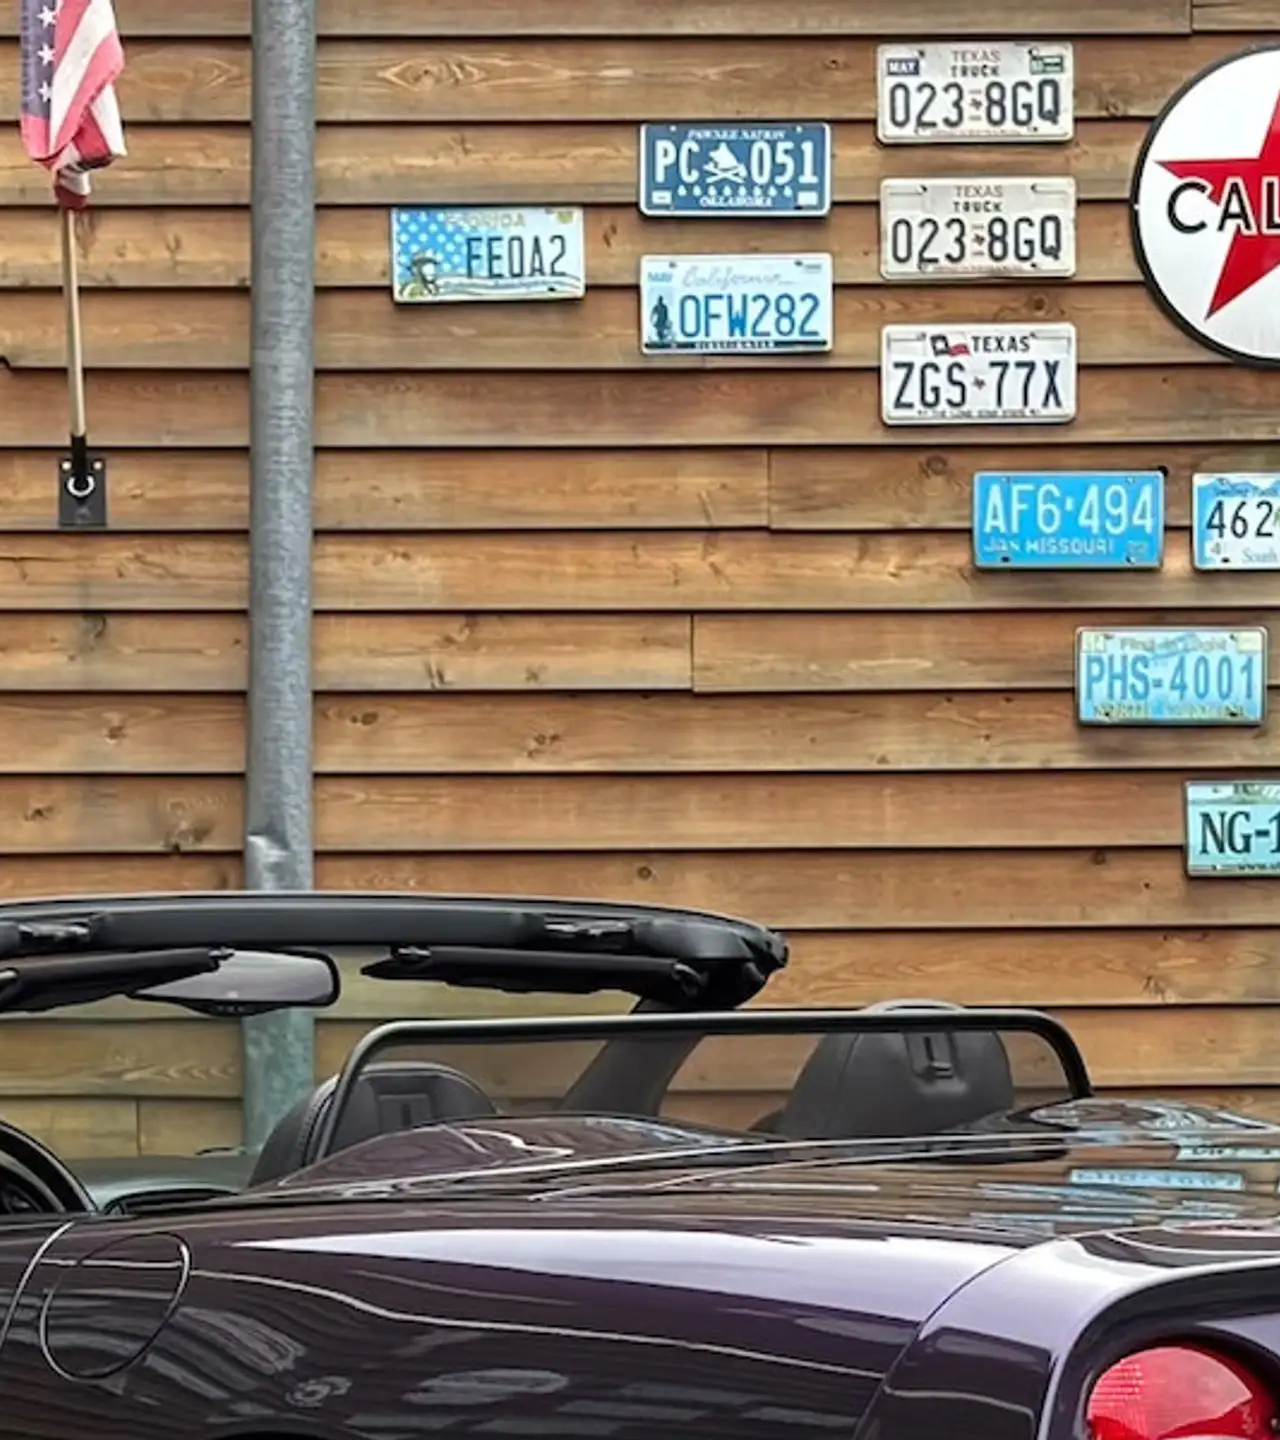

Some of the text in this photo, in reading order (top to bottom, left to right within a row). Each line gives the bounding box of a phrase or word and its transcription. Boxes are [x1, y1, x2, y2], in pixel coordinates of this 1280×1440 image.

[951, 50, 1001, 62] TEXAS
[890, 61, 916, 73] MAY
[951, 65, 1000, 77] TRUCK
[654, 139, 819, 185] PC 051
[956, 185, 1004, 198] TEXAS
[953, 202, 1002, 212] TRUCK
[971, 335, 1030, 353] TEXAS
[1025, 536, 1115, 554] MISSOURI
[1085, 654, 1254, 701] PHS-4001
